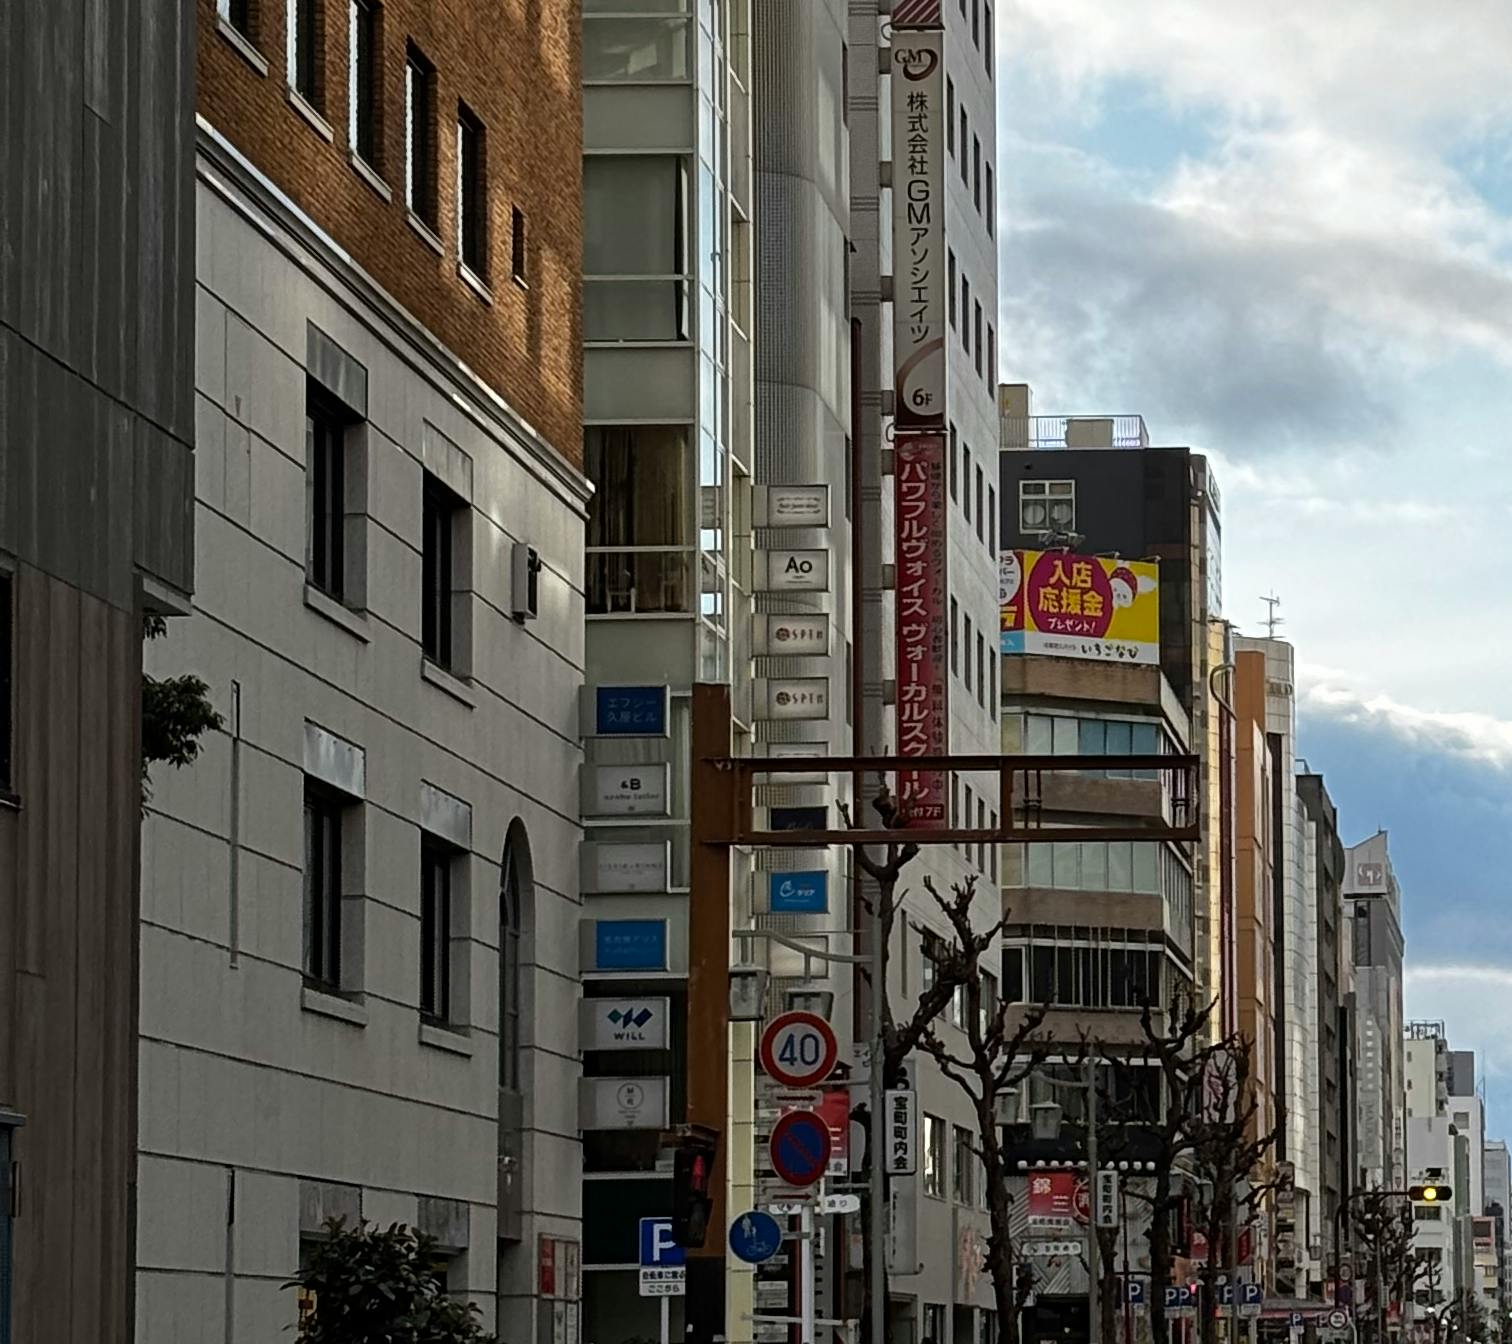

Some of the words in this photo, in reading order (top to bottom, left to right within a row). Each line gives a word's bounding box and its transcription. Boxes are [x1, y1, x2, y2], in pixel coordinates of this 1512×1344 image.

[906, 91, 931, 344] 株式会社GMアソシエイツ
[912, 387, 933, 407] 6F
[785, 556, 813, 574] Ao
[1048, 559, 1094, 588] 入店
[1038, 586, 1105, 618] 応援金
[613, 1032, 646, 1041] WILL
[778, 1033, 819, 1066] 40
[893, 1095, 908, 1171] 宝町町内会
